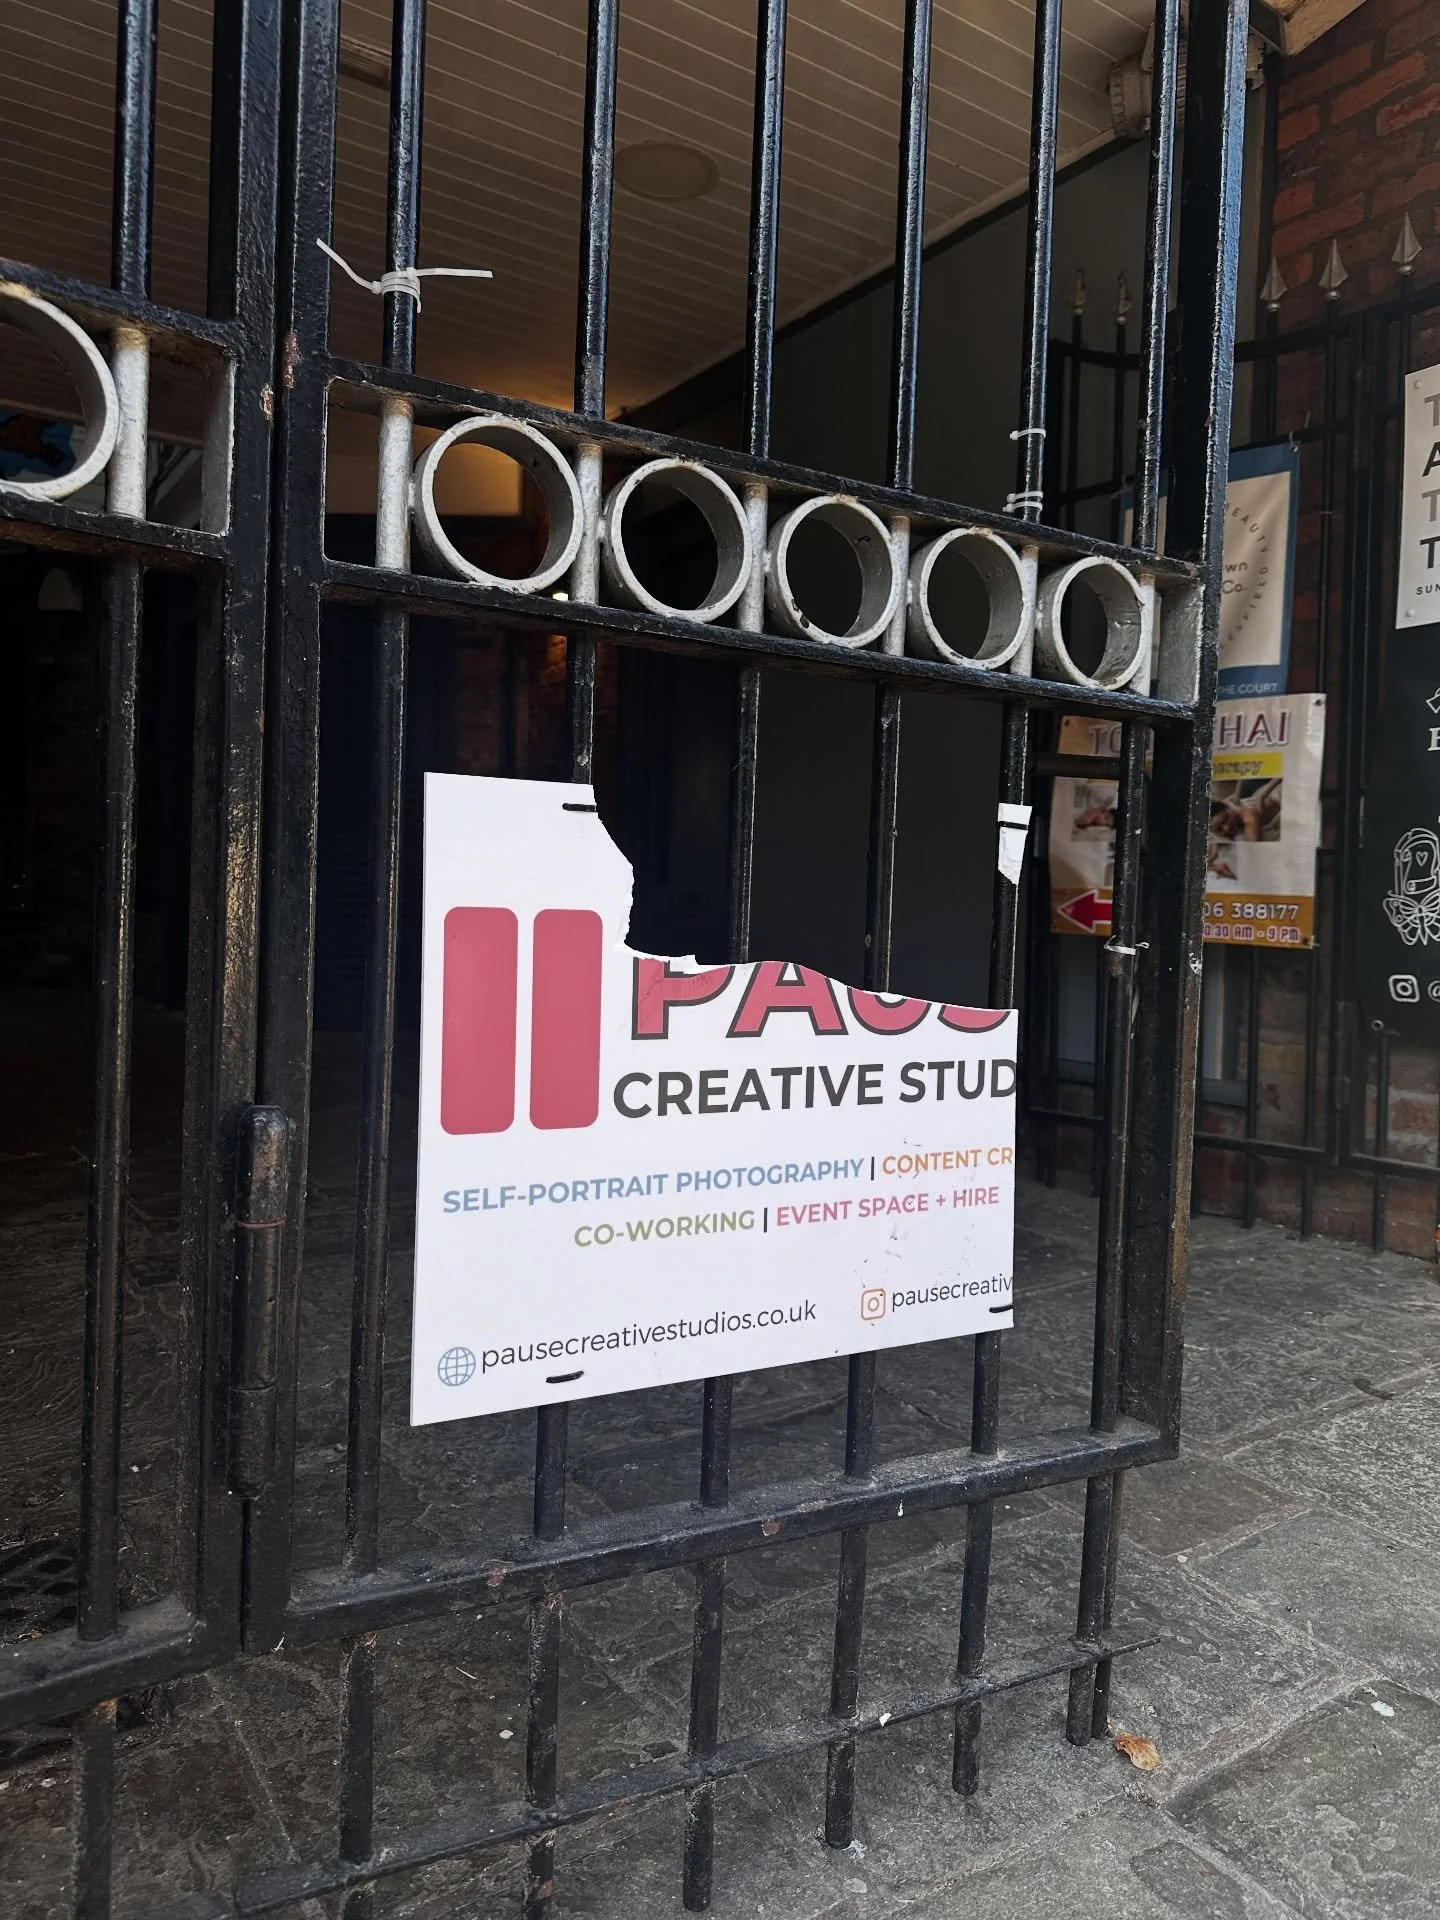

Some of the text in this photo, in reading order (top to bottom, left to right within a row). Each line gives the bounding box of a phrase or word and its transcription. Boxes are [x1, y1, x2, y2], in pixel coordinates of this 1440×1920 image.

[1237, 682, 1278, 694] COURT
[1218, 710, 1289, 749] HAI
[1231, 902, 1299, 920] 388177
[1203, 923, 1231, 939] 0:30
[1266, 925, 1278, 942] 9
[613, 1058, 1016, 1119] CREATIVE STUD
[443, 1173, 669, 1213] SELF-PORTRAIT
[676, 1158, 865, 1193] PHOTOGRAPHY
[882, 1149, 982, 1175] CONTENT
[987, 1147, 1013, 1165] CR
[574, 1209, 755, 1247] CO-WORKING
[776, 1200, 852, 1227] EVENT
[858, 1193, 929, 1218] SPACE
[953, 1186, 1000, 1208] HIRE
[892, 1273, 1013, 1312] pausecreativ
[481, 1299, 816, 1374] pausecreativestudios.co.uk
